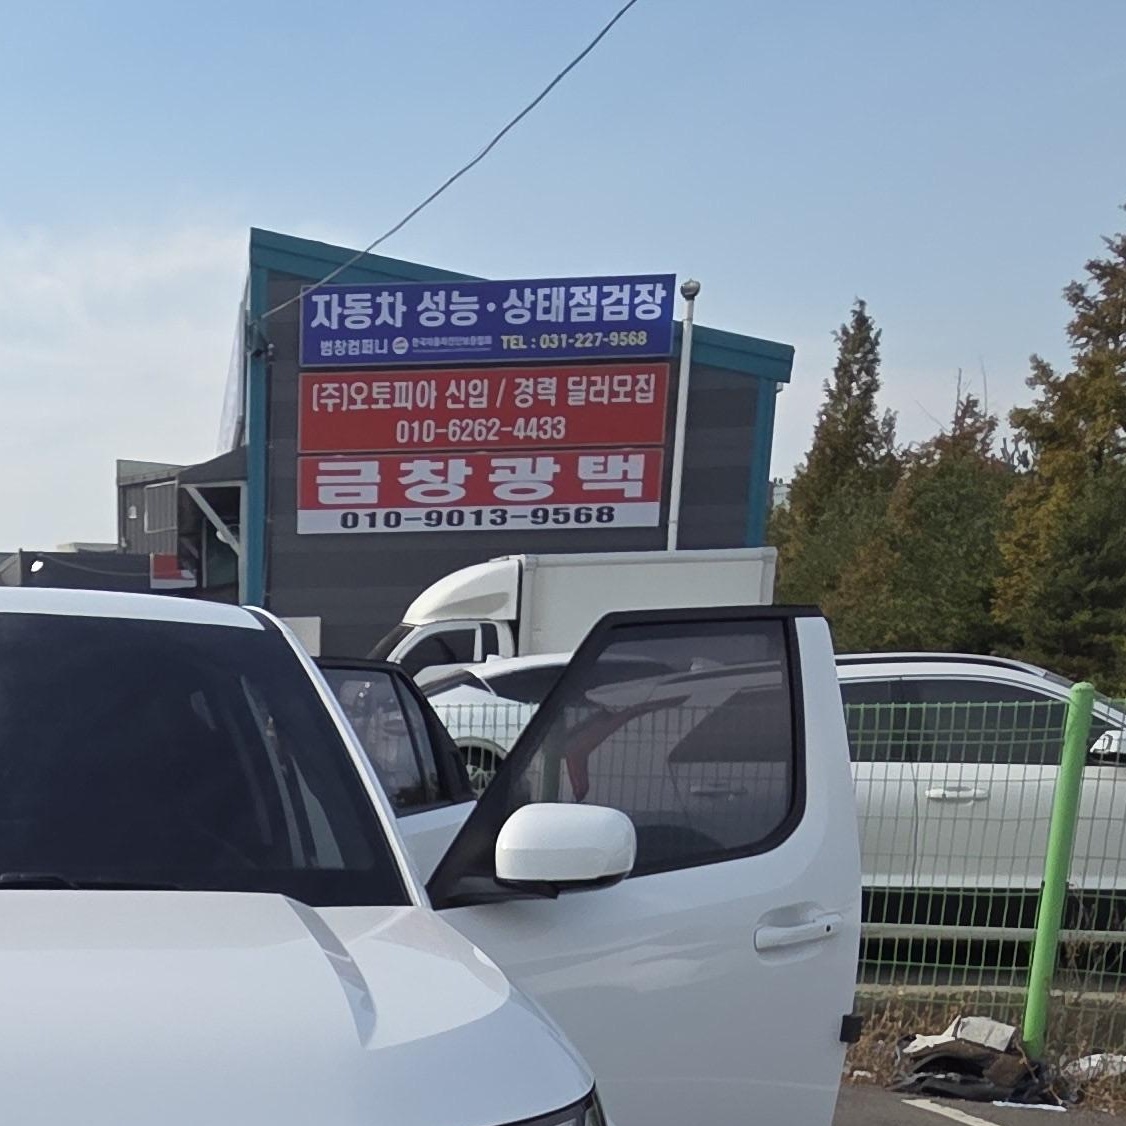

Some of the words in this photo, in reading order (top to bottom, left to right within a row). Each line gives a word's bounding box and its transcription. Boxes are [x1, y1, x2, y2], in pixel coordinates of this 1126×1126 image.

[311, 291, 407, 330] 자동차
[312, 380, 436, 412] (주)오토피아
[445, 379, 489, 409] 신입
[513, 377, 557, 406] 경력
[567, 373, 656, 406] 딜러모집
[396, 416, 566, 443] 010-6262-4433
[340, 505, 616, 529] 010-9013-9568
